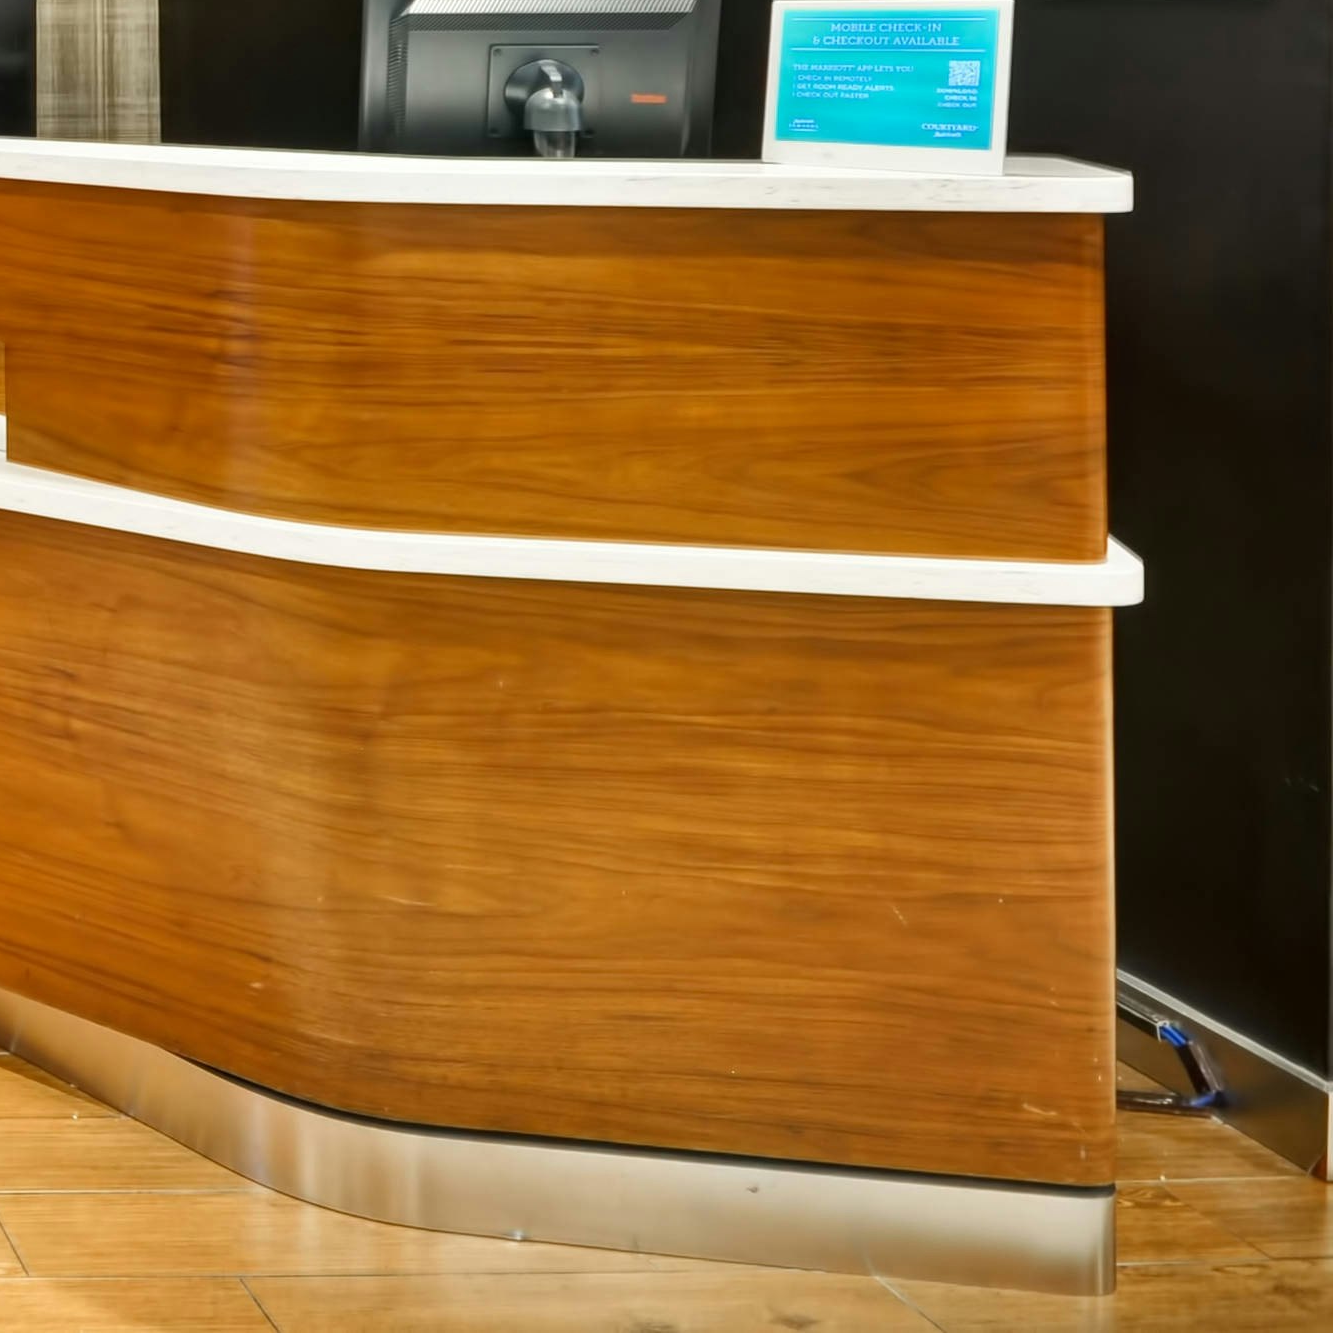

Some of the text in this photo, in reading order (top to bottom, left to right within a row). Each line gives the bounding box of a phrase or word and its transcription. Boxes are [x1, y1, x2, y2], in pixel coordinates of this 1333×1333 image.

[831, 23, 876, 32] MOBILE
[822, 36, 889, 45] CHECKOUT
[893, 37, 960, 46] AVAILABLE
